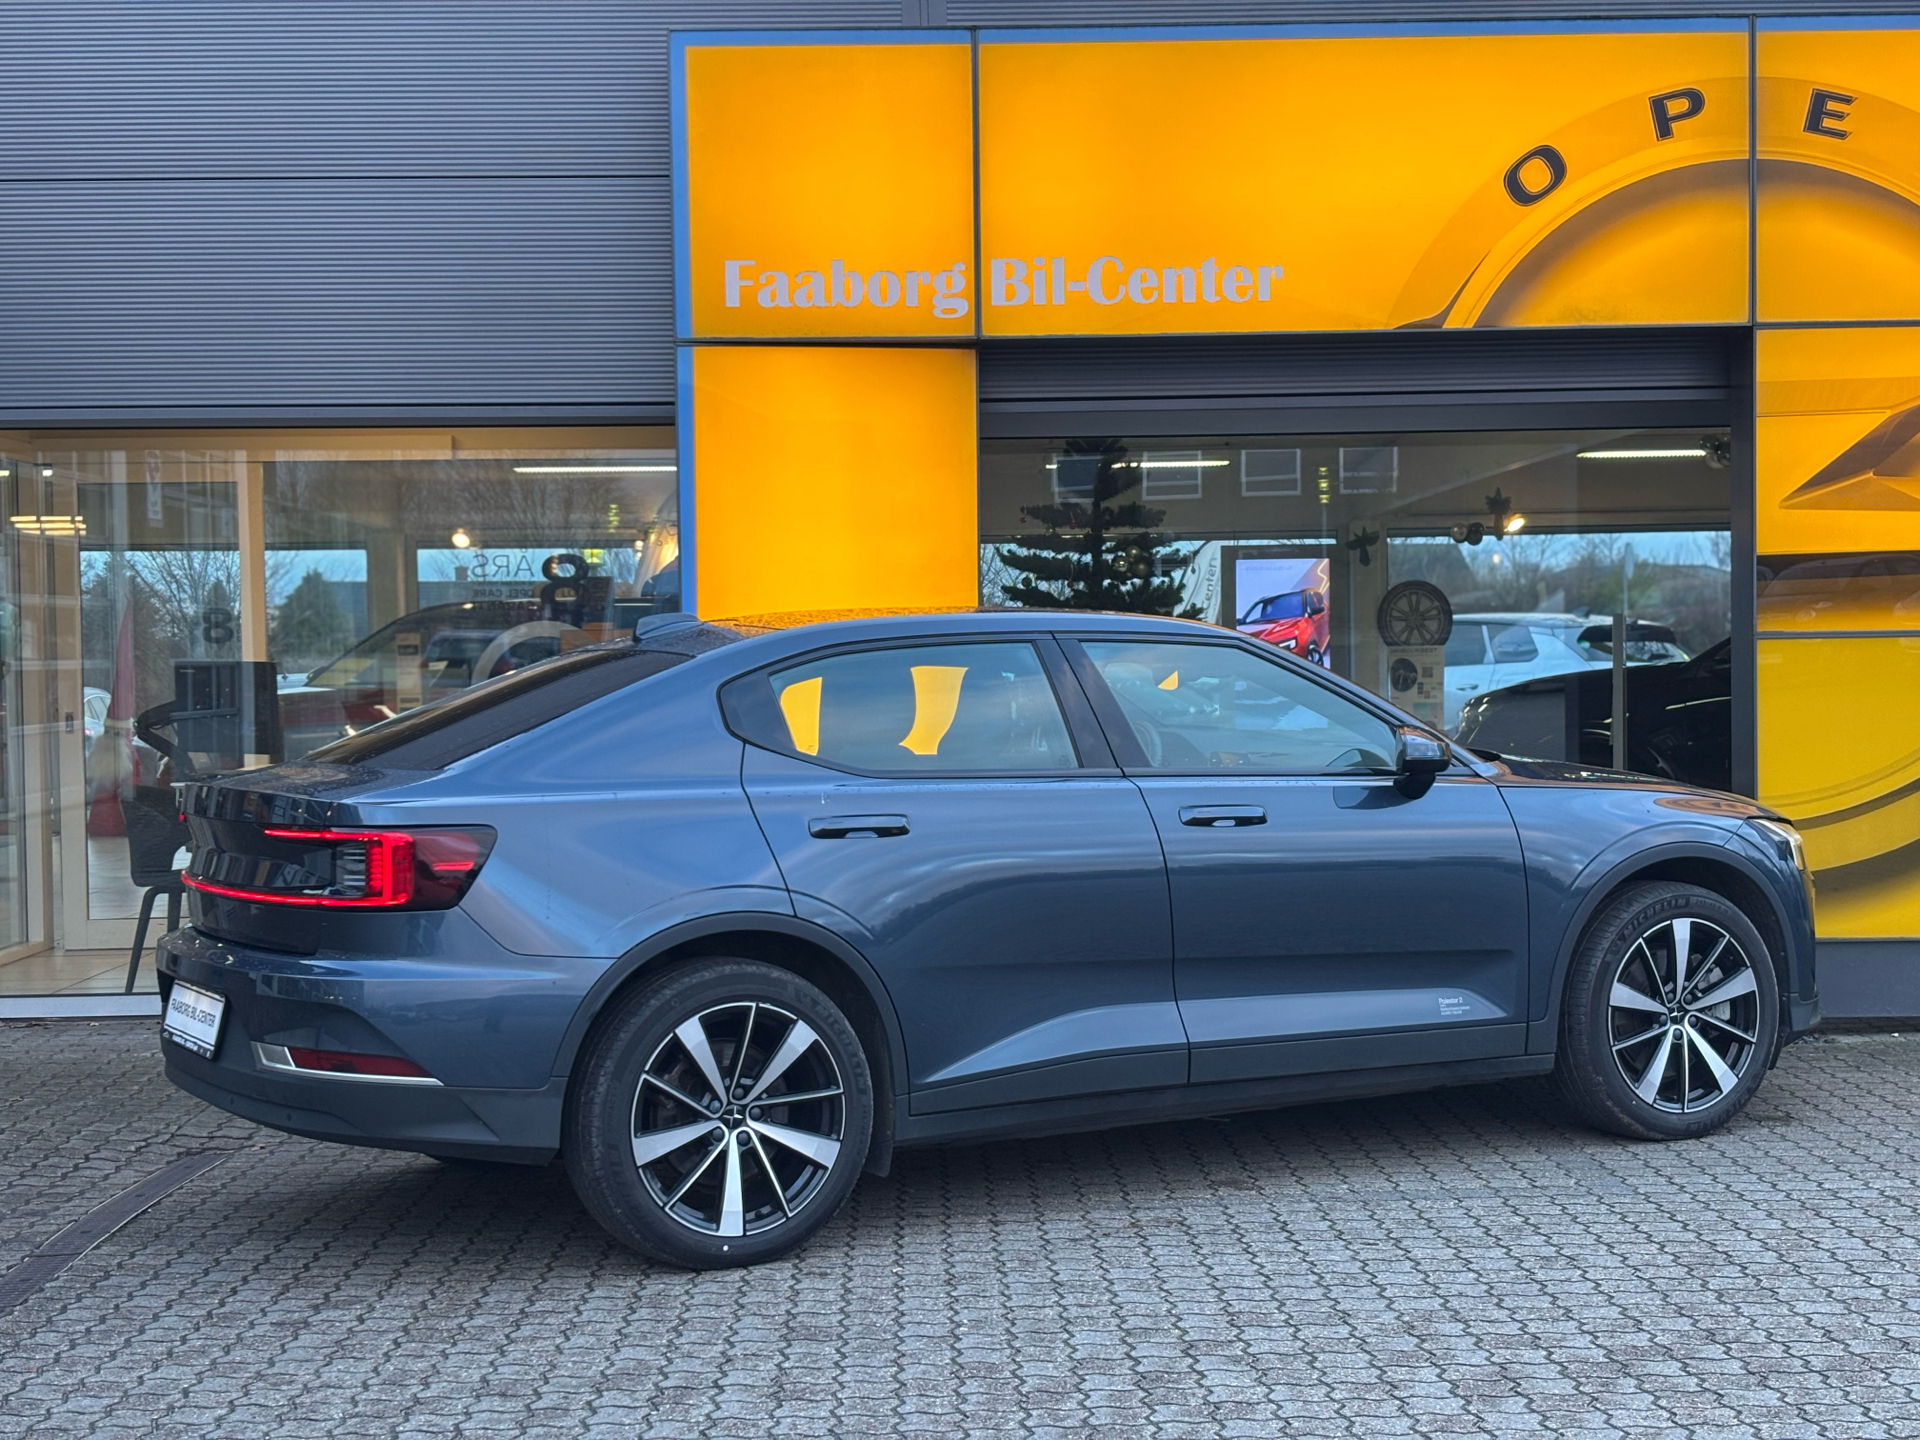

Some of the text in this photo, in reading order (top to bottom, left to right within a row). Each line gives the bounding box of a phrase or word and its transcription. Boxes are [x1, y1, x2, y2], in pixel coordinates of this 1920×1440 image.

[724, 256, 1284, 318] Faaborg Bil-Center
[1624, 897, 1687, 938] MICHELIN
[814, 1004, 867, 1090] MICHELIN
